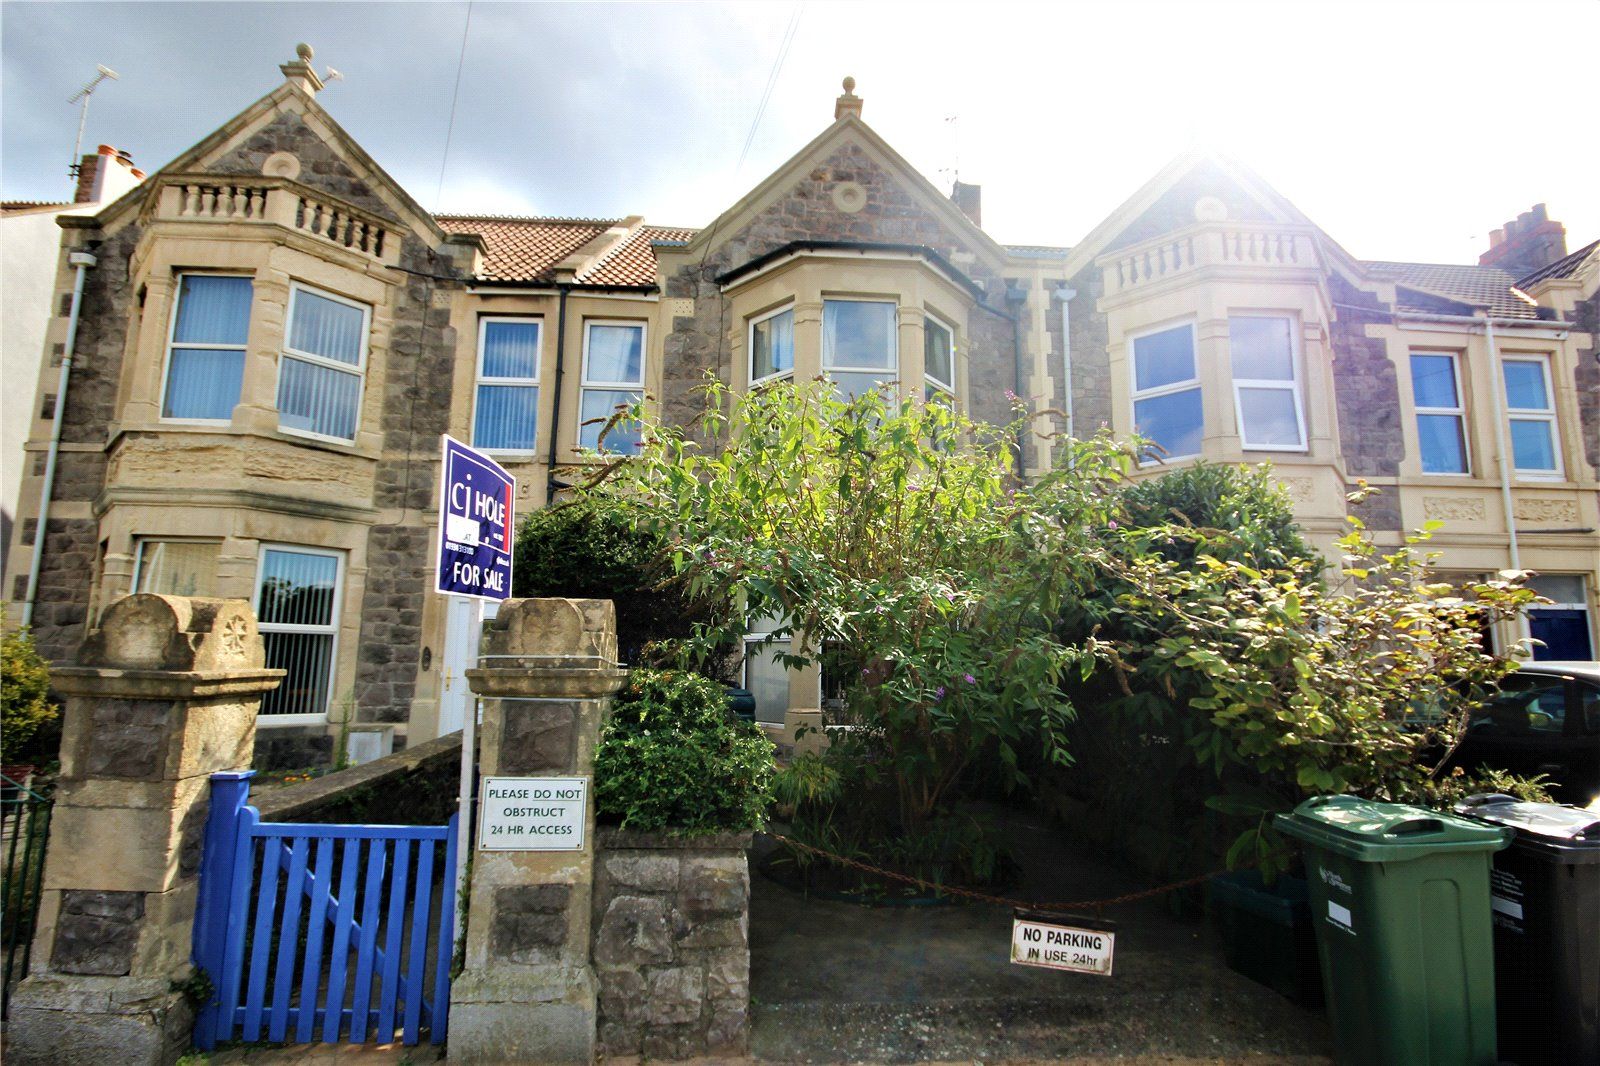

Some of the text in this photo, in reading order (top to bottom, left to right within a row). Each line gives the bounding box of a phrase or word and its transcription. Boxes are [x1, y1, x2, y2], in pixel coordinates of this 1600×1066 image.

[475, 490, 506, 527] HOLE
[453, 561, 480, 587] FOR
[483, 568, 504, 592] SALE
[489, 789, 582, 799] PLEASE DO NOT
[503, 807, 566, 817] OBSTRUCT
[491, 825, 573, 835] 24 HR ACCESS
[1023, 927, 1102, 950] NO PARKING
[1028, 947, 1098, 966] IN USE 24hr
